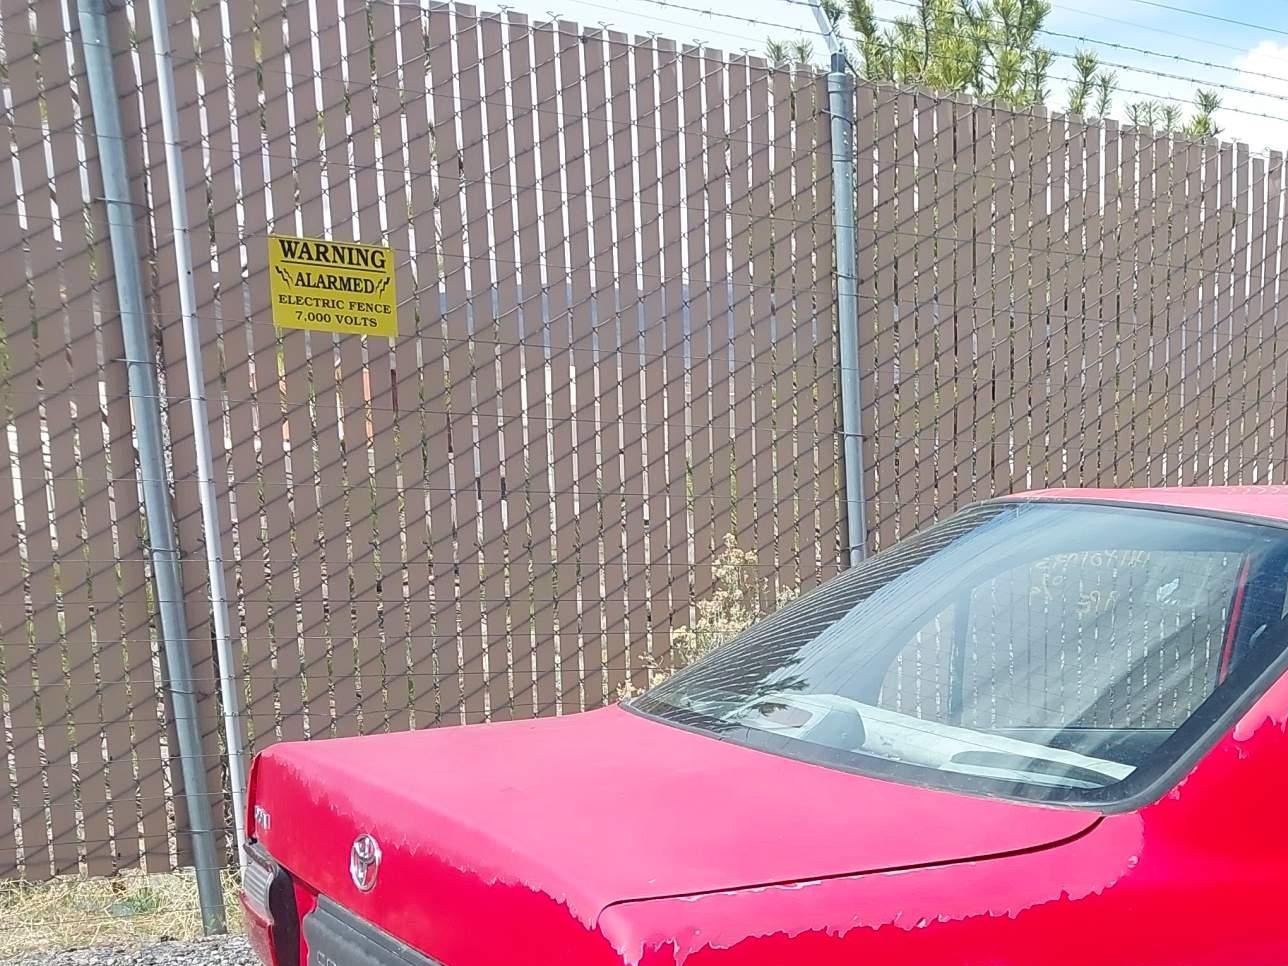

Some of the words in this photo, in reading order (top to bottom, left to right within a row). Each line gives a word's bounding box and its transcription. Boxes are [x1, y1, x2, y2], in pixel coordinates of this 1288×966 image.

[279, 239, 386, 268] WARNING
[295, 272, 374, 294] ALARMED
[278, 294, 345, 309] ELECTRIC
[349, 301, 391, 314] FENCE
[295, 311, 331, 323] 7,000
[335, 314, 377, 327] VOLTS
